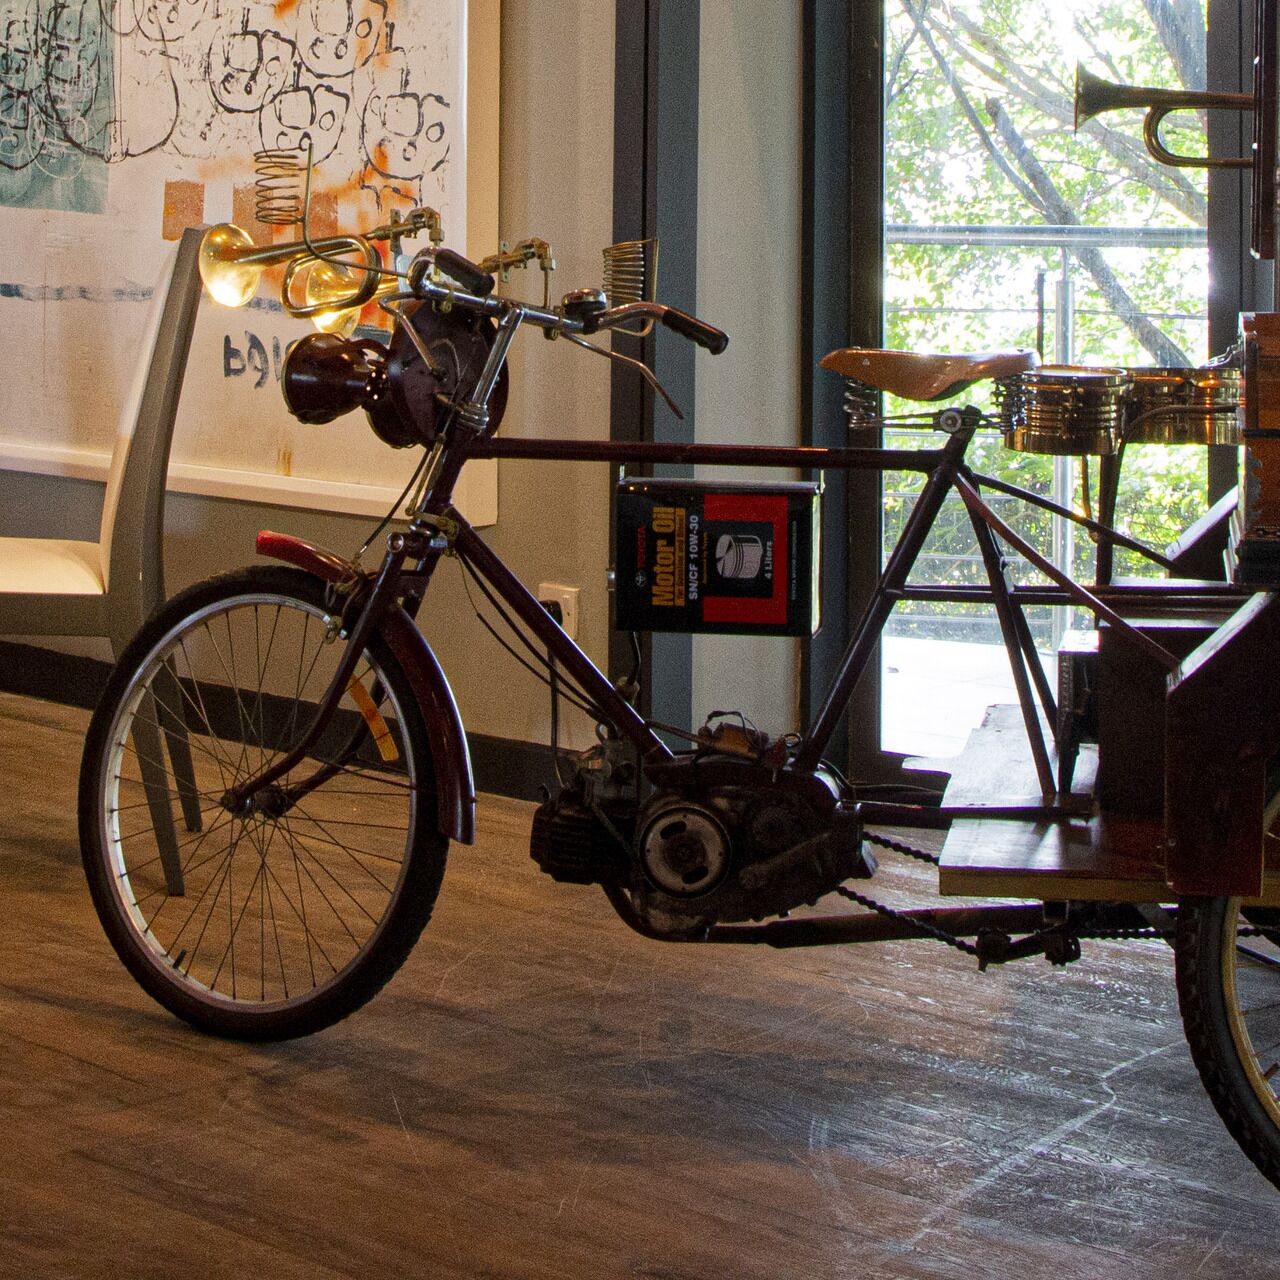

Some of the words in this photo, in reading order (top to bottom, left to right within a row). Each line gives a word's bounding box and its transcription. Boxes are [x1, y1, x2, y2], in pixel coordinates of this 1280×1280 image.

[651, 506, 675, 534] Oil
[688, 514, 699, 560] 10W-30
[636, 526, 647, 570] TOYOTA
[763, 540, 774, 570] Liters
[651, 539, 675, 607] Motor
[688, 563, 699, 601] SN/CF
